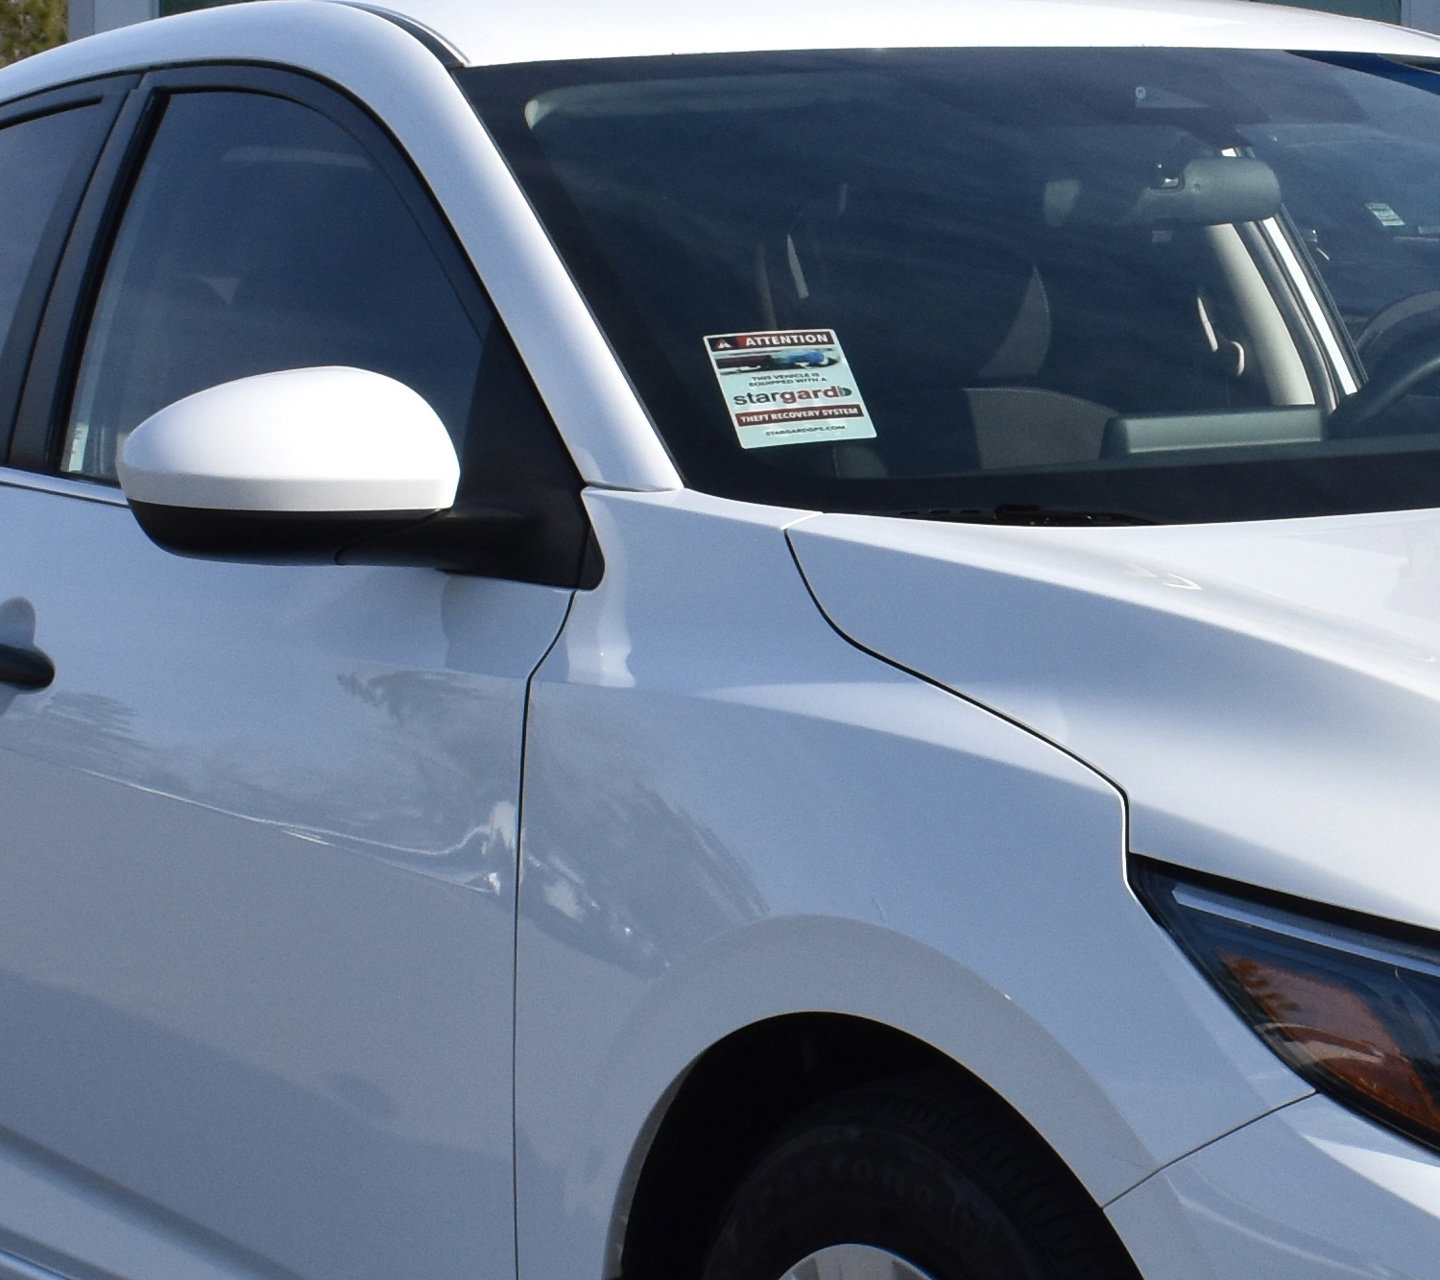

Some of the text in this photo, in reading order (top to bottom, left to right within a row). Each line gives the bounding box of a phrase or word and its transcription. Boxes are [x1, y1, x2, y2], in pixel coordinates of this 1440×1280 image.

[745, 333, 828, 347] ATTENTION
[733, 385, 839, 405] stargard
[741, 407, 859, 423] THEFT RECOVERY SYSTEM
